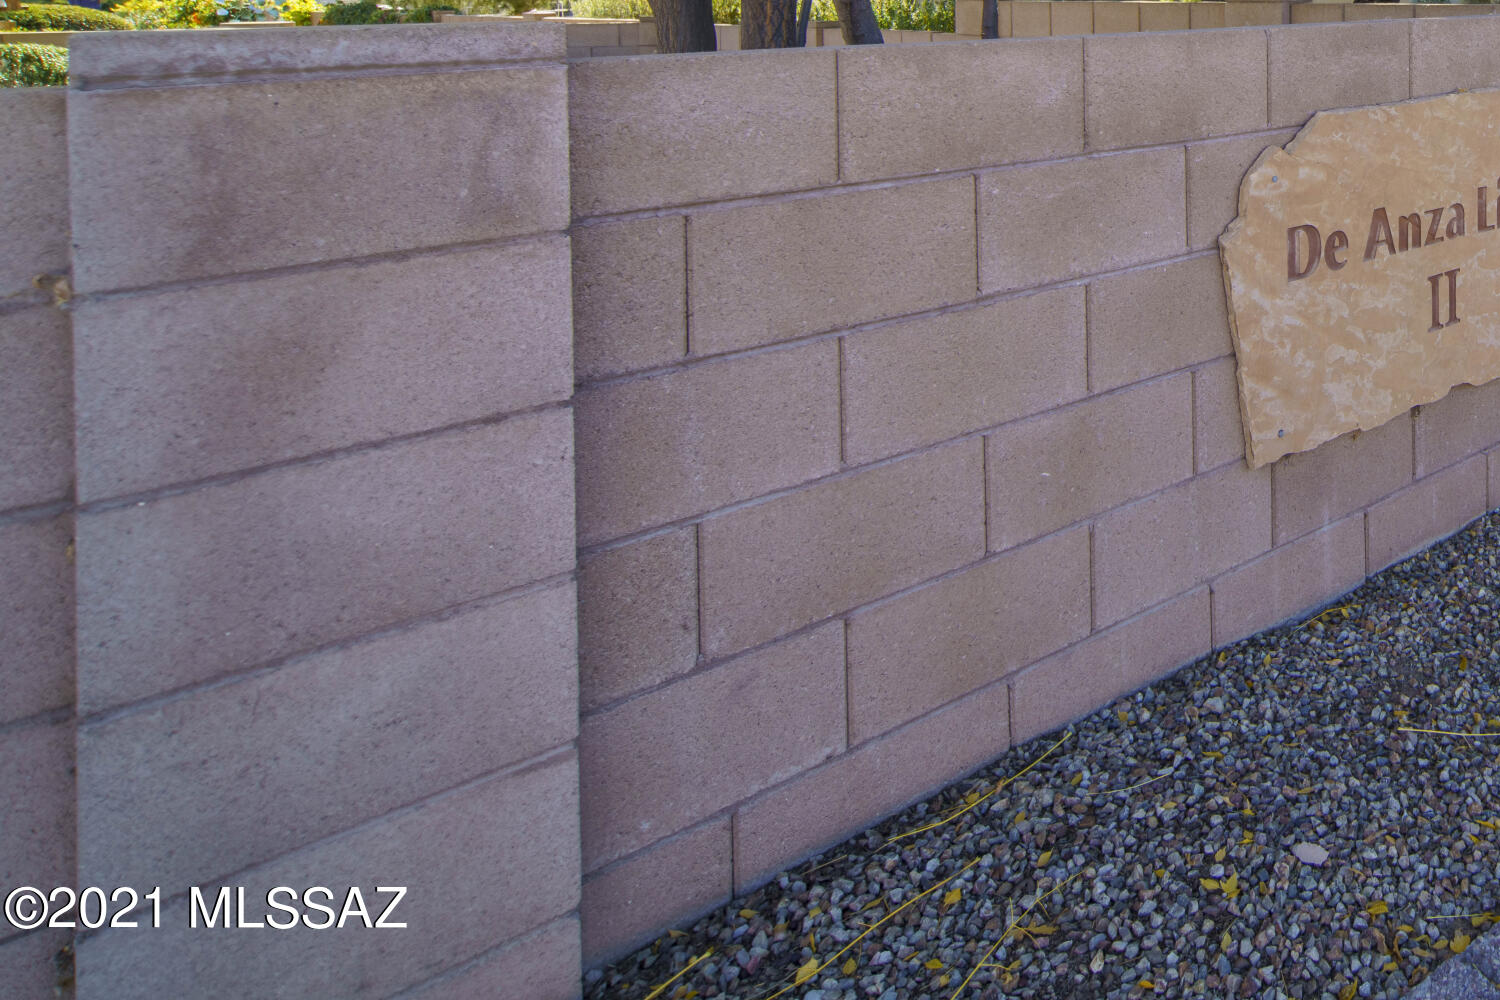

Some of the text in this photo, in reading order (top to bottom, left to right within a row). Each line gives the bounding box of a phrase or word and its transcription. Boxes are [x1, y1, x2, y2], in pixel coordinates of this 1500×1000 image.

[1287, 224, 1349, 283] De
[1363, 202, 1466, 262] Anza
[1427, 268, 1461, 332] II
